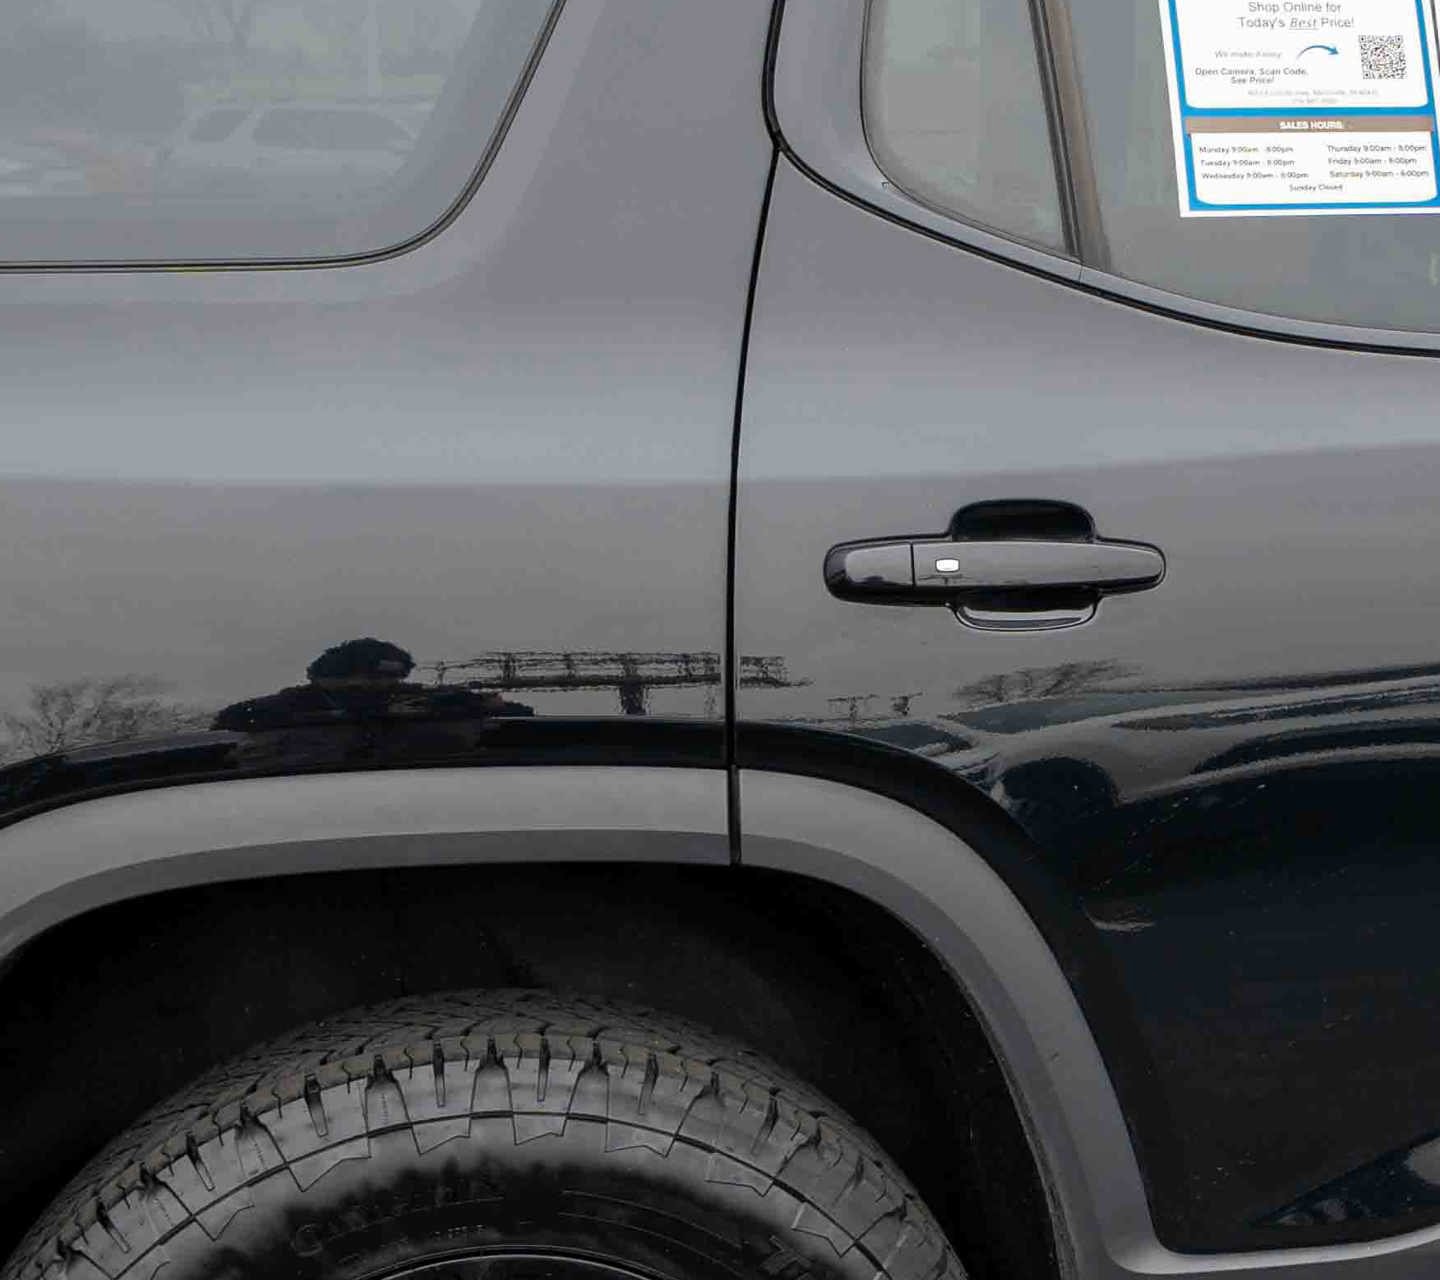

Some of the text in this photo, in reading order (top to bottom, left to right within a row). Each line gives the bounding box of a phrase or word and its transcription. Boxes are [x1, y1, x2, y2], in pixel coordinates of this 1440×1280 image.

[1248, 1, 1341, 13] Shop Online for
[1236, 16, 1354, 29] Today's Best Price!
[1195, 68, 1218, 76] Open
[1260, 68, 1280, 76] Scan
[1231, 76, 1246, 84] See
[1280, 121, 1310, 129] SALES
[1200, 146, 1229, 154] Monday
[1327, 145, 1361, 153] Thursday
[1202, 172, 1244, 180] Wednesday
[1329, 170, 1363, 178] Saturday
[1289, 184, 1316, 192] Sunday
